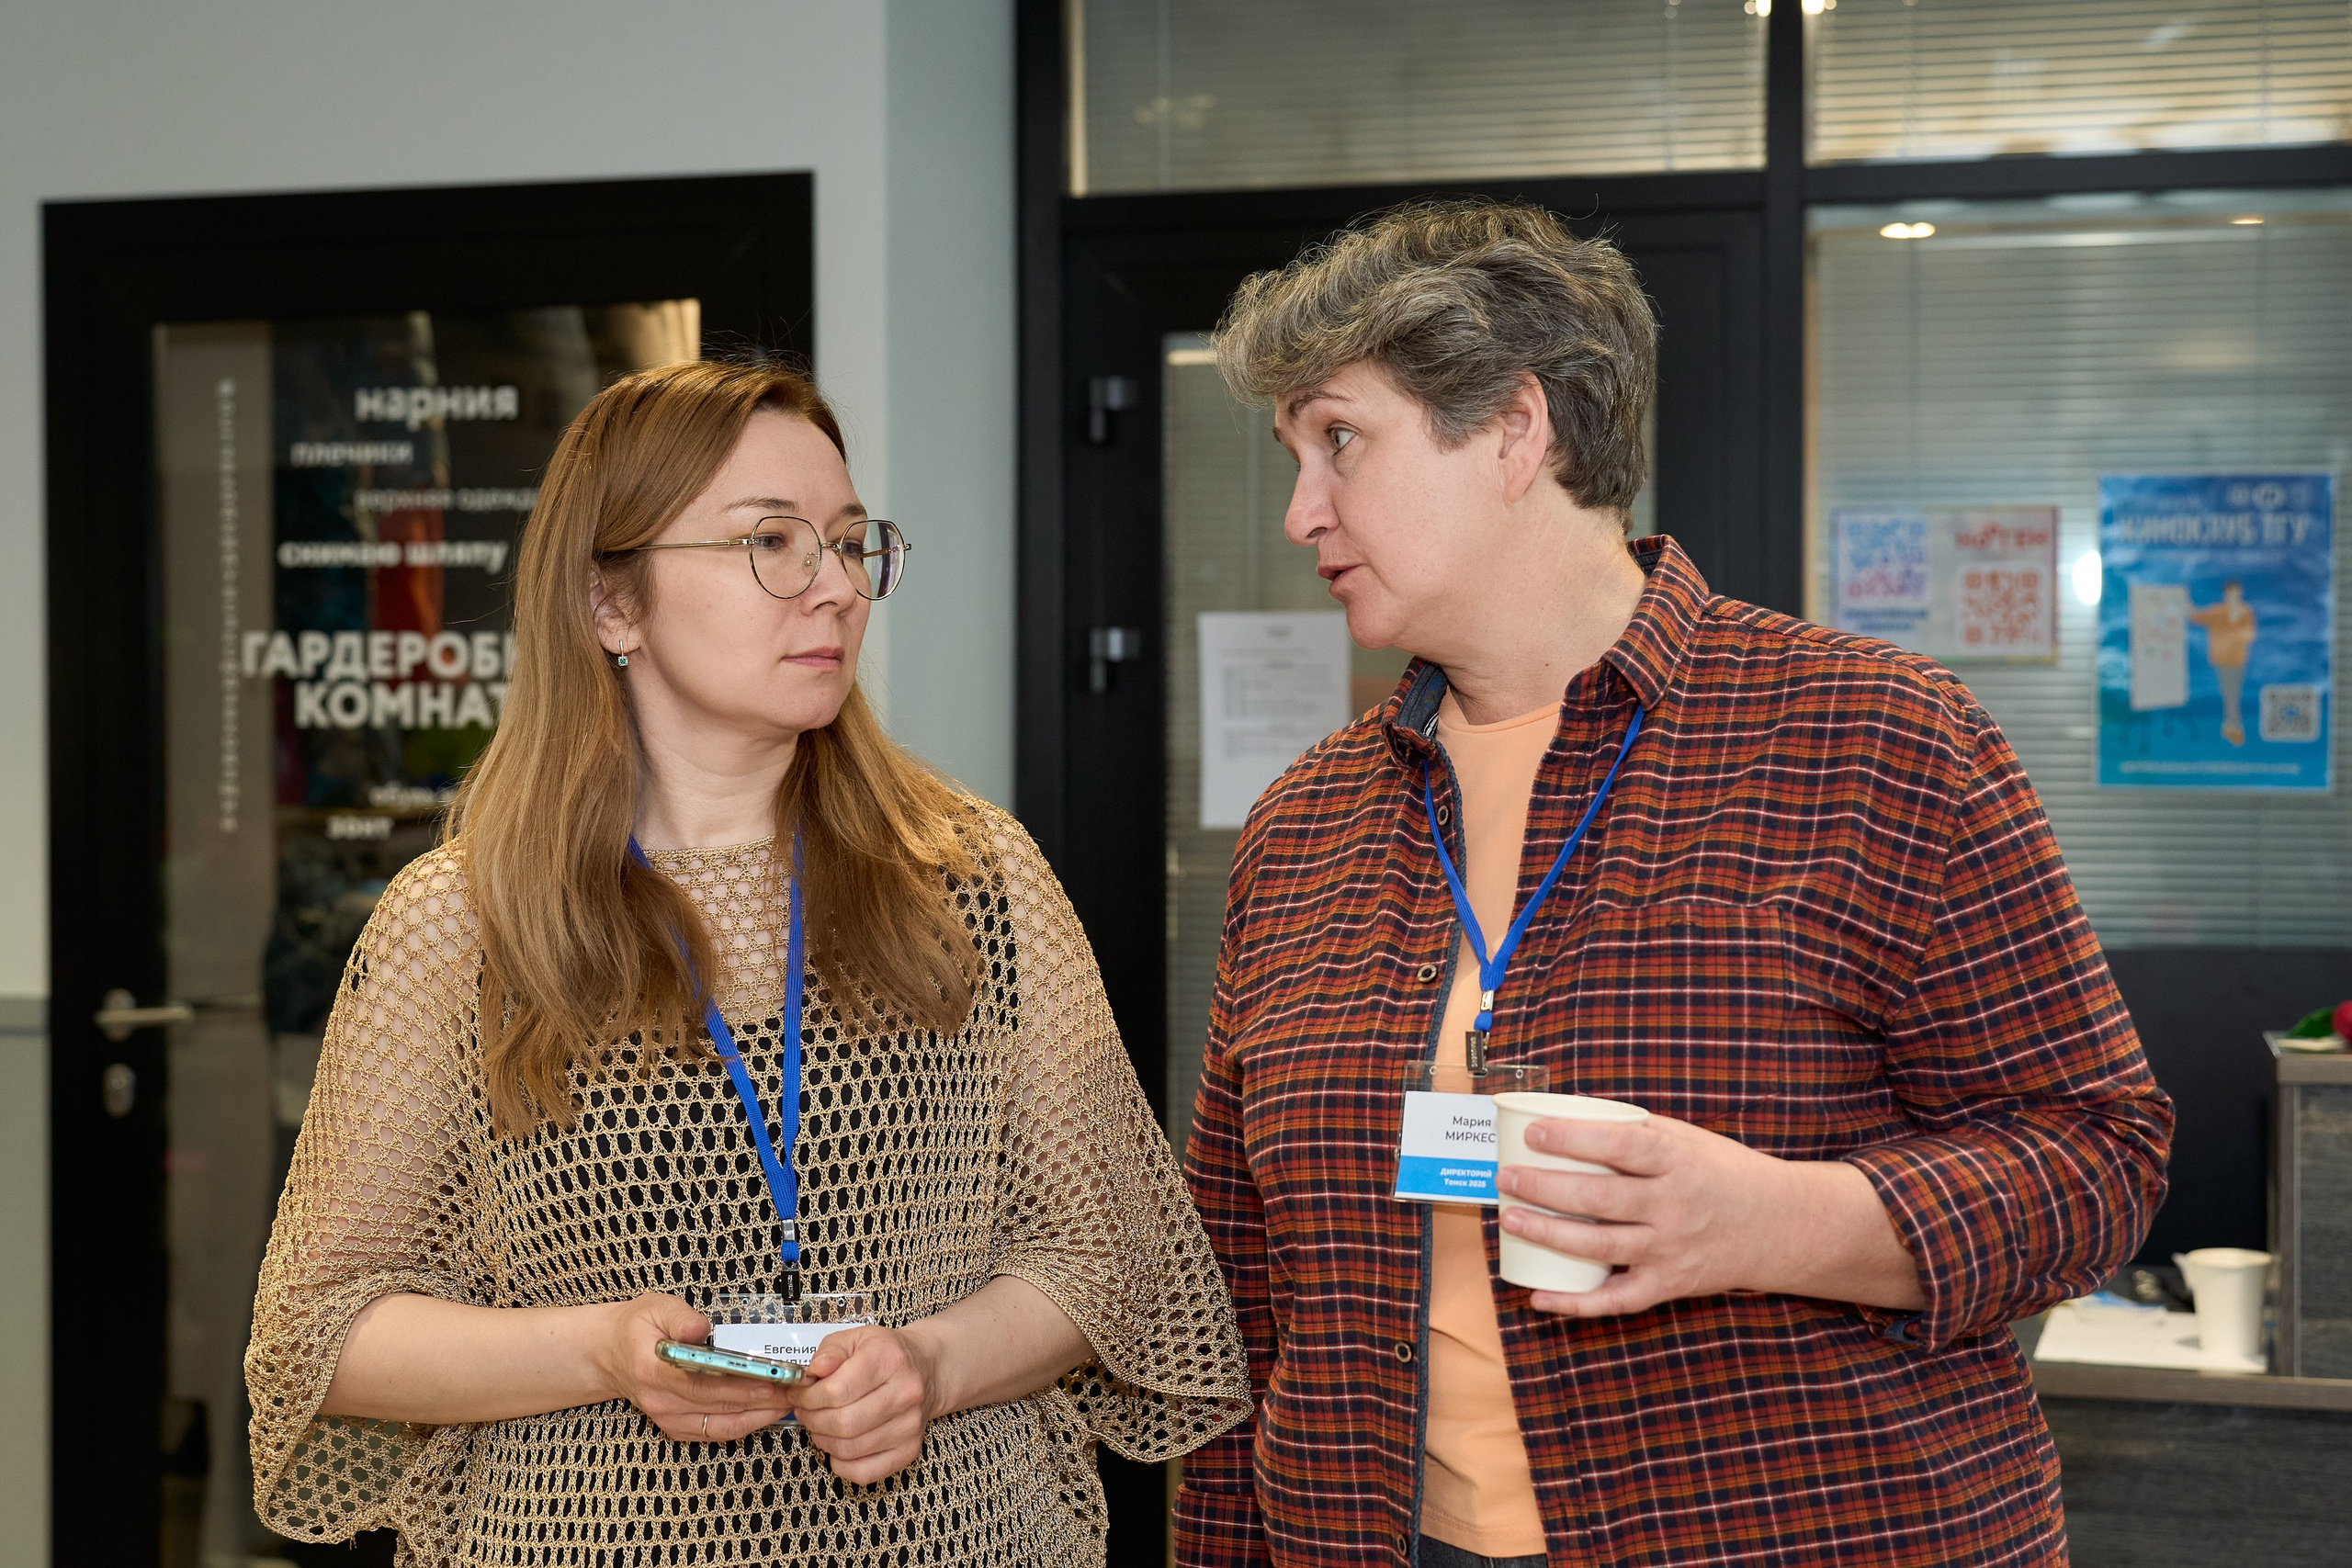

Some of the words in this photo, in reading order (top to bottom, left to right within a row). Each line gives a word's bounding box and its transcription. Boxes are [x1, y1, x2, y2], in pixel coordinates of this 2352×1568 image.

[355, 387, 518, 431] нарния
[325, 815, 394, 840] зонт
[1452, 1115, 1492, 1129] Мария
[1444, 1130, 1497, 1144] МИРКЕС
[1443, 1178, 1468, 1187] Томск
[763, 1344, 817, 1355] Евгения
